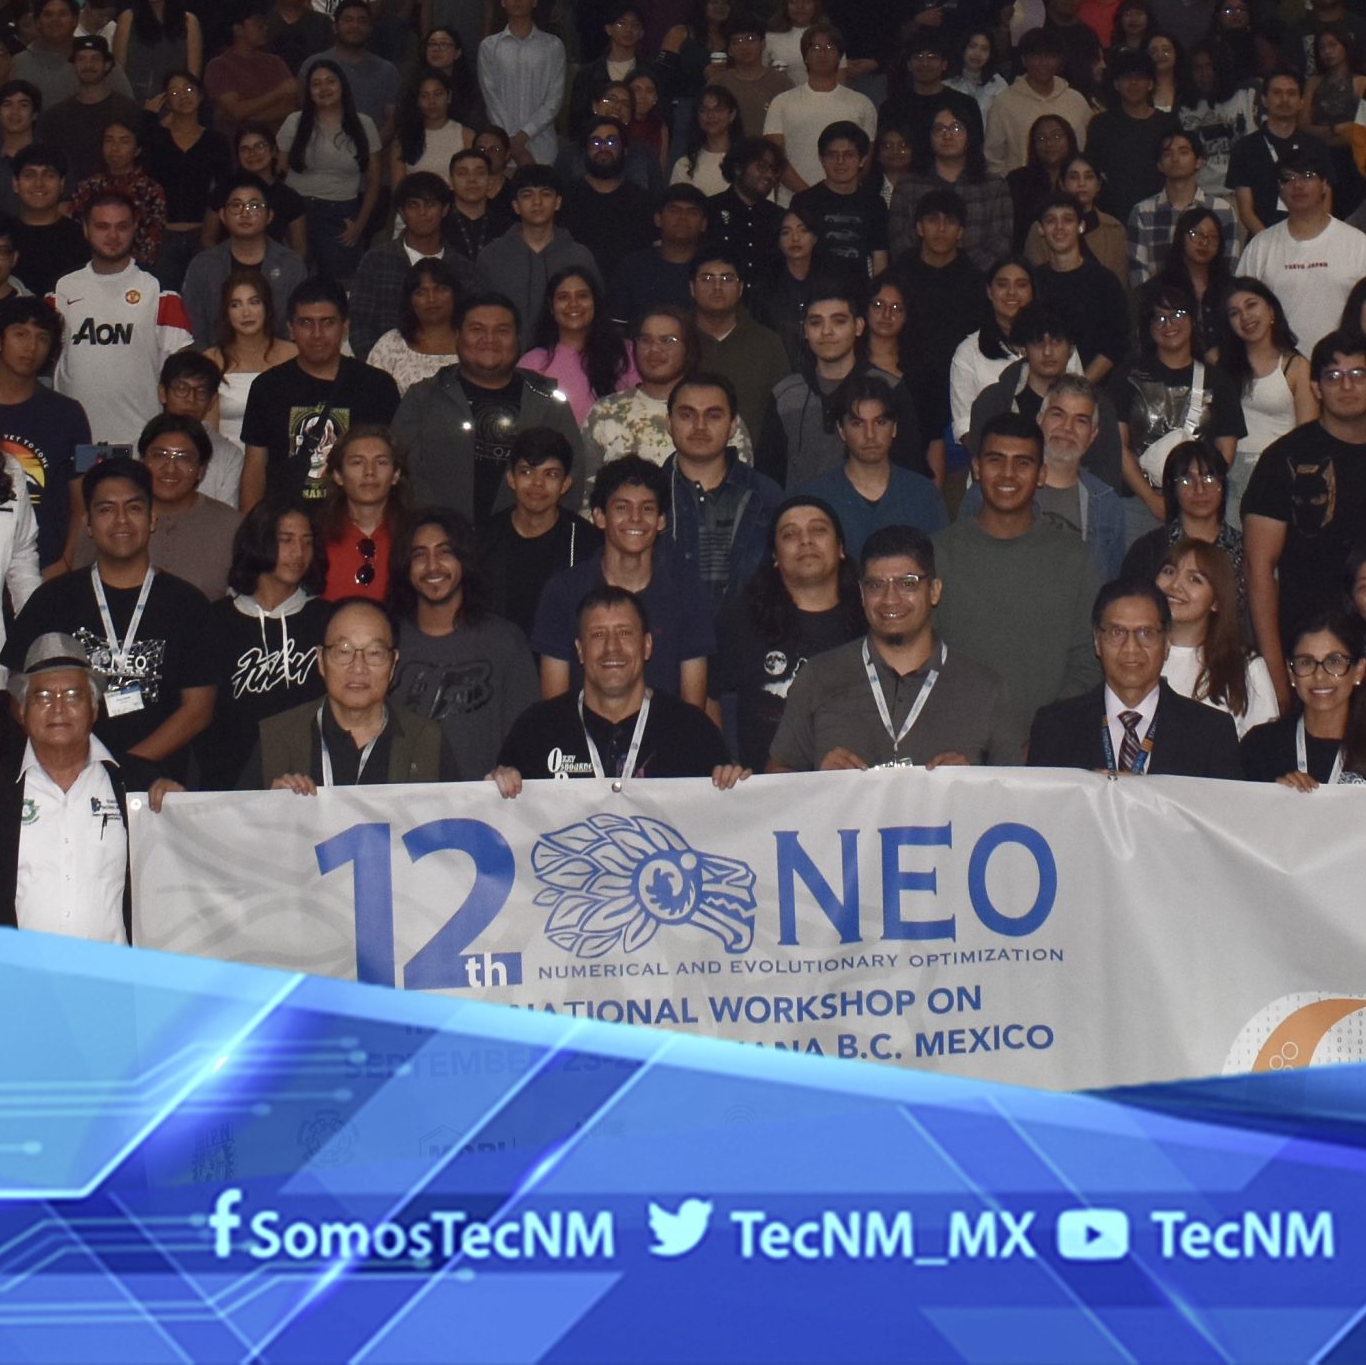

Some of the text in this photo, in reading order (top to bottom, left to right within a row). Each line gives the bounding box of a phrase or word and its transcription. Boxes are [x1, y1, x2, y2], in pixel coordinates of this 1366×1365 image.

[775, 822, 1058, 946] NEO
[538, 947, 1064, 980] NUMERICAL AND EVOLUTIONARY OPTIMIZATION
[708, 988, 916, 1023] WORKSHOP
[927, 984, 982, 1014] ON
[837, 1033, 903, 1060] B.C.
[915, 1023, 1055, 1058] MEXICO
